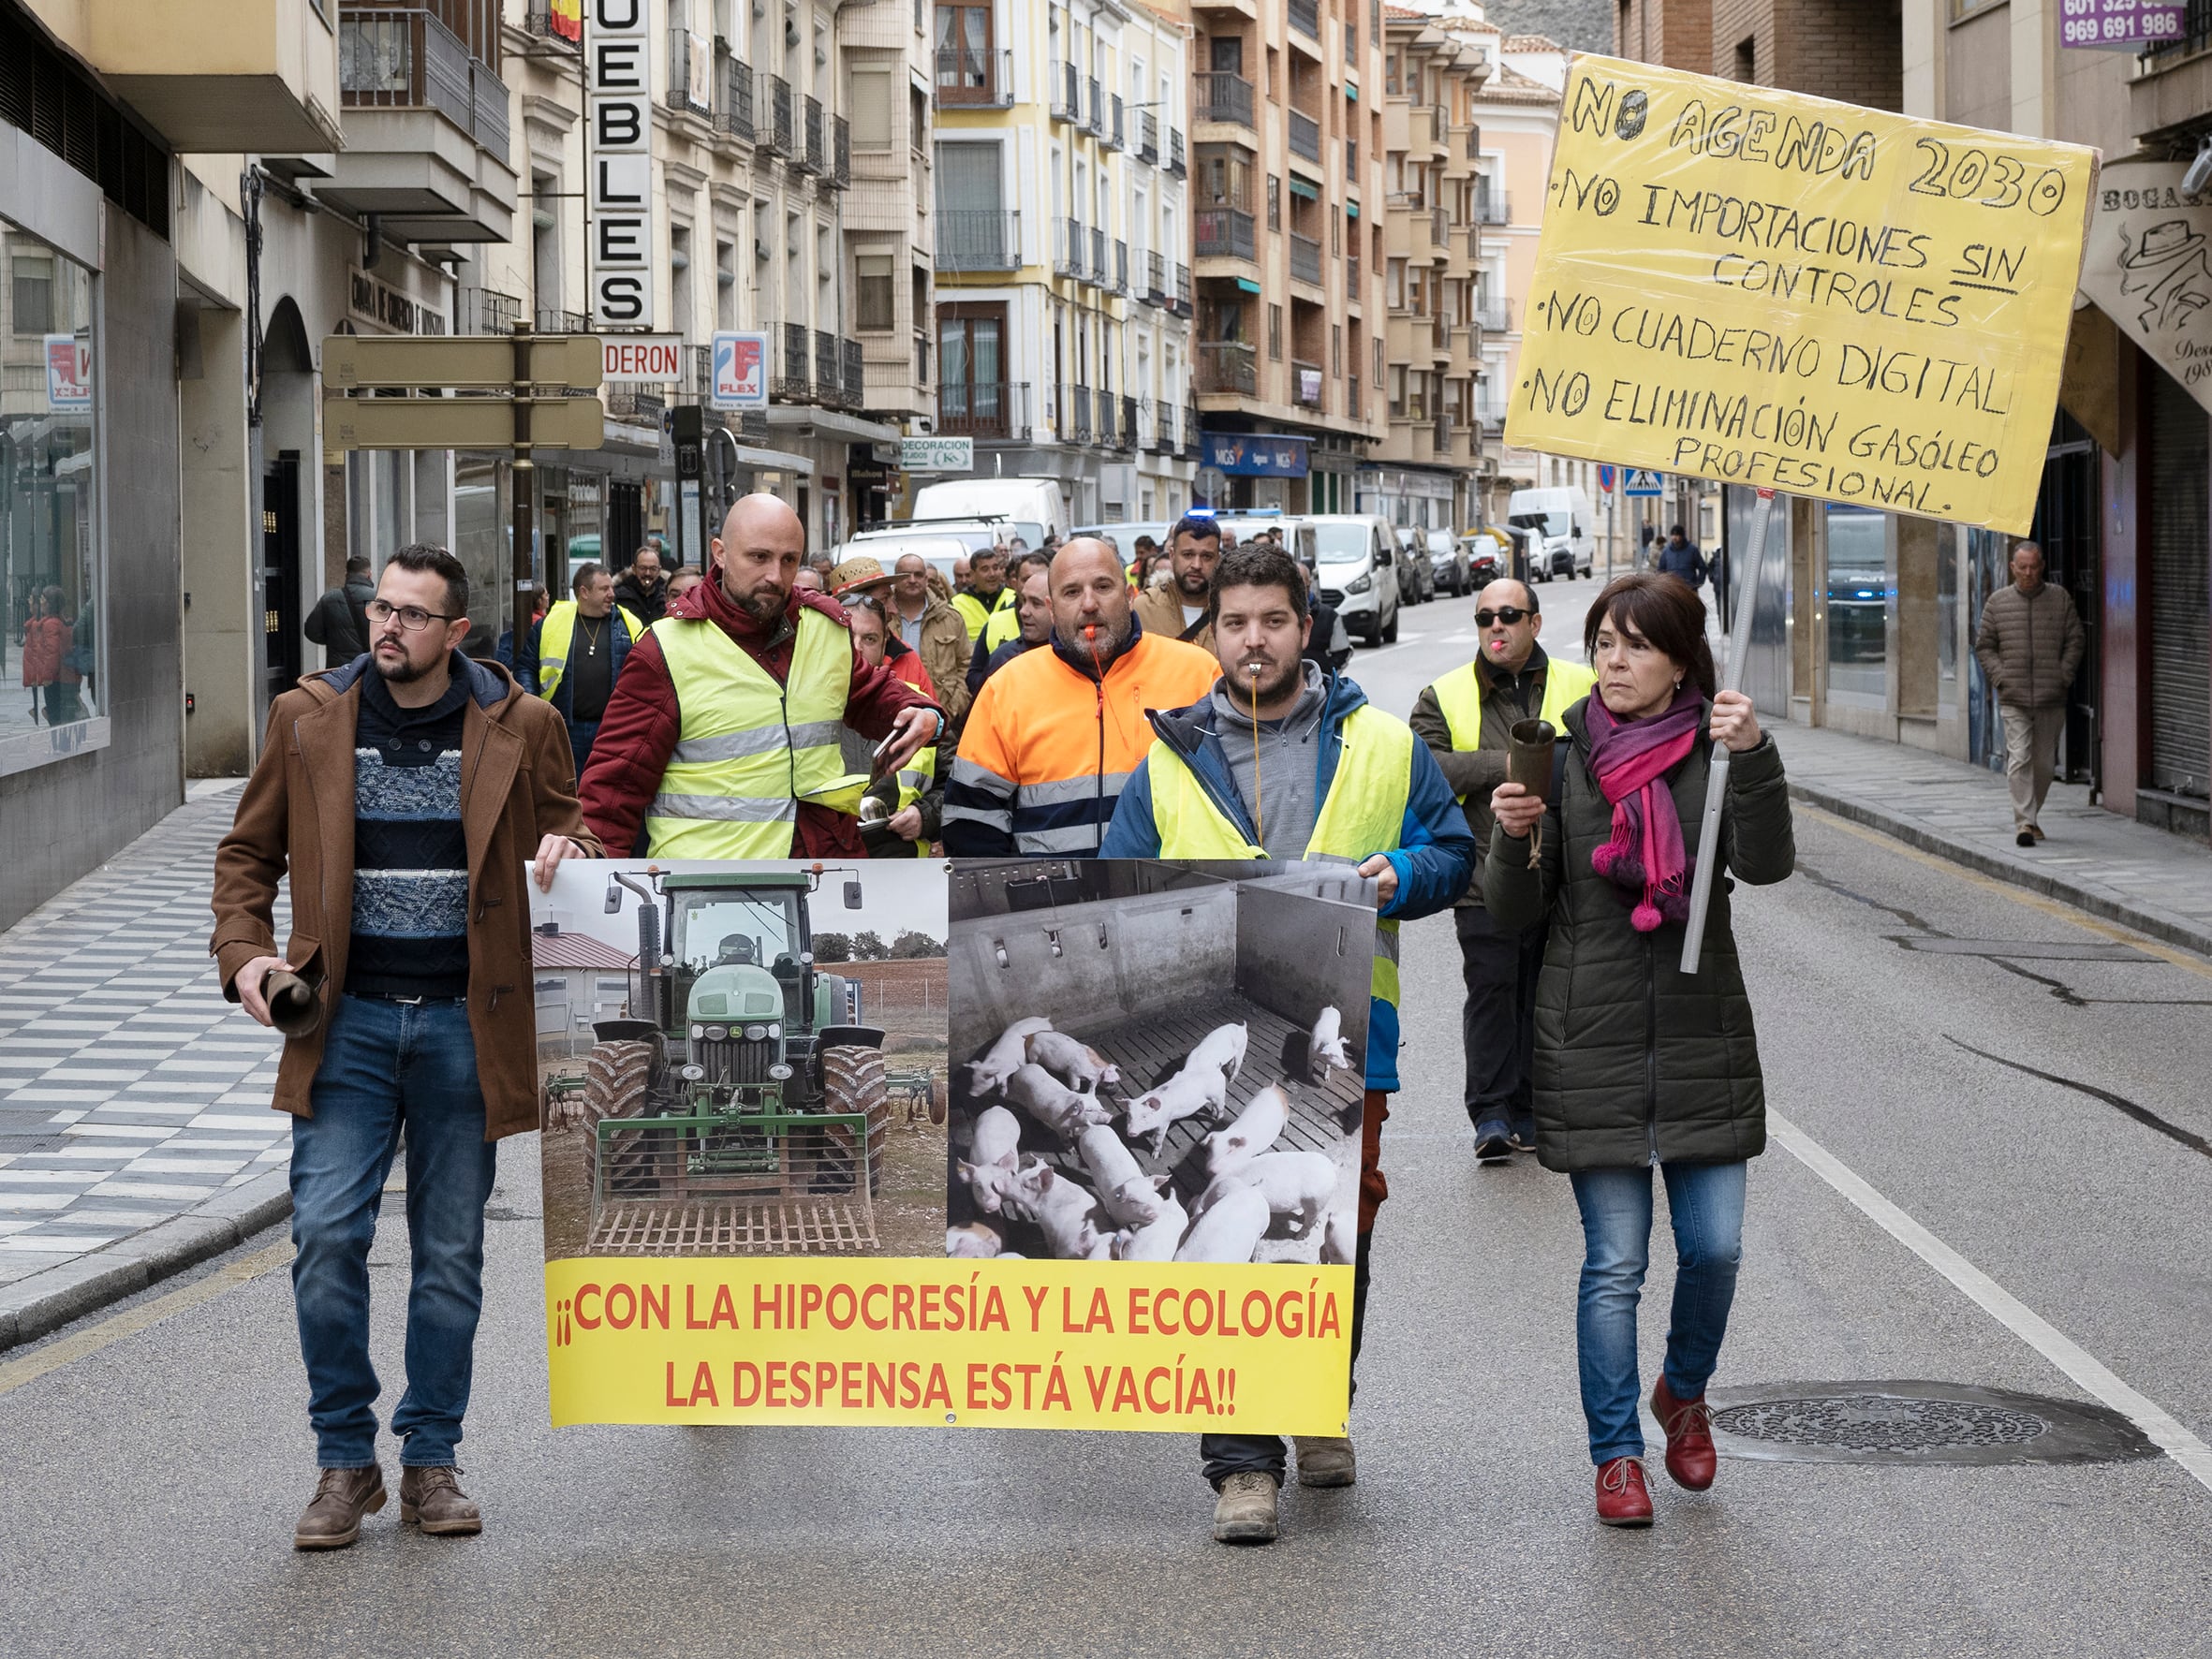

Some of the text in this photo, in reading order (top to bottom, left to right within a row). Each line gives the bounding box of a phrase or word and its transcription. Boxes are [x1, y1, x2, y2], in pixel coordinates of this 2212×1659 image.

[2065, 19, 2098, 42] 969
[2103, 16, 2134, 38] 691
[2142, 12, 2176, 35] 986
[1573, 76, 2066, 216] NO AGENDA 2030
[1560, 168, 2028, 282] NO IMPORTACIONES SIN
[2101, 185, 2212, 212] BOGA
[1713, 254, 1962, 328] CONTROLES
[602, 345, 677, 374] DERON
[1542, 289, 1601, 337] NO
[1612, 306, 1821, 378] CUADERNO
[1838, 345, 2007, 416] DIGITAL
[719, 384, 757, 394] FLEX
[1530, 368, 1998, 478] NO ELIMINACIÓN GASÓLEO
[902, 440, 969, 450] DECORACION
[1215, 448, 1235, 465] MGS
[1674, 437, 1953, 513] PROFESIONAL.
[556, 1271, 1341, 1347] ¡¡CON LA HIPOCRESÍA Y LA ECOLOGÍA
[666, 1351, 1236, 1417] LA DESPENSA ESTÁ VACÍA!!
